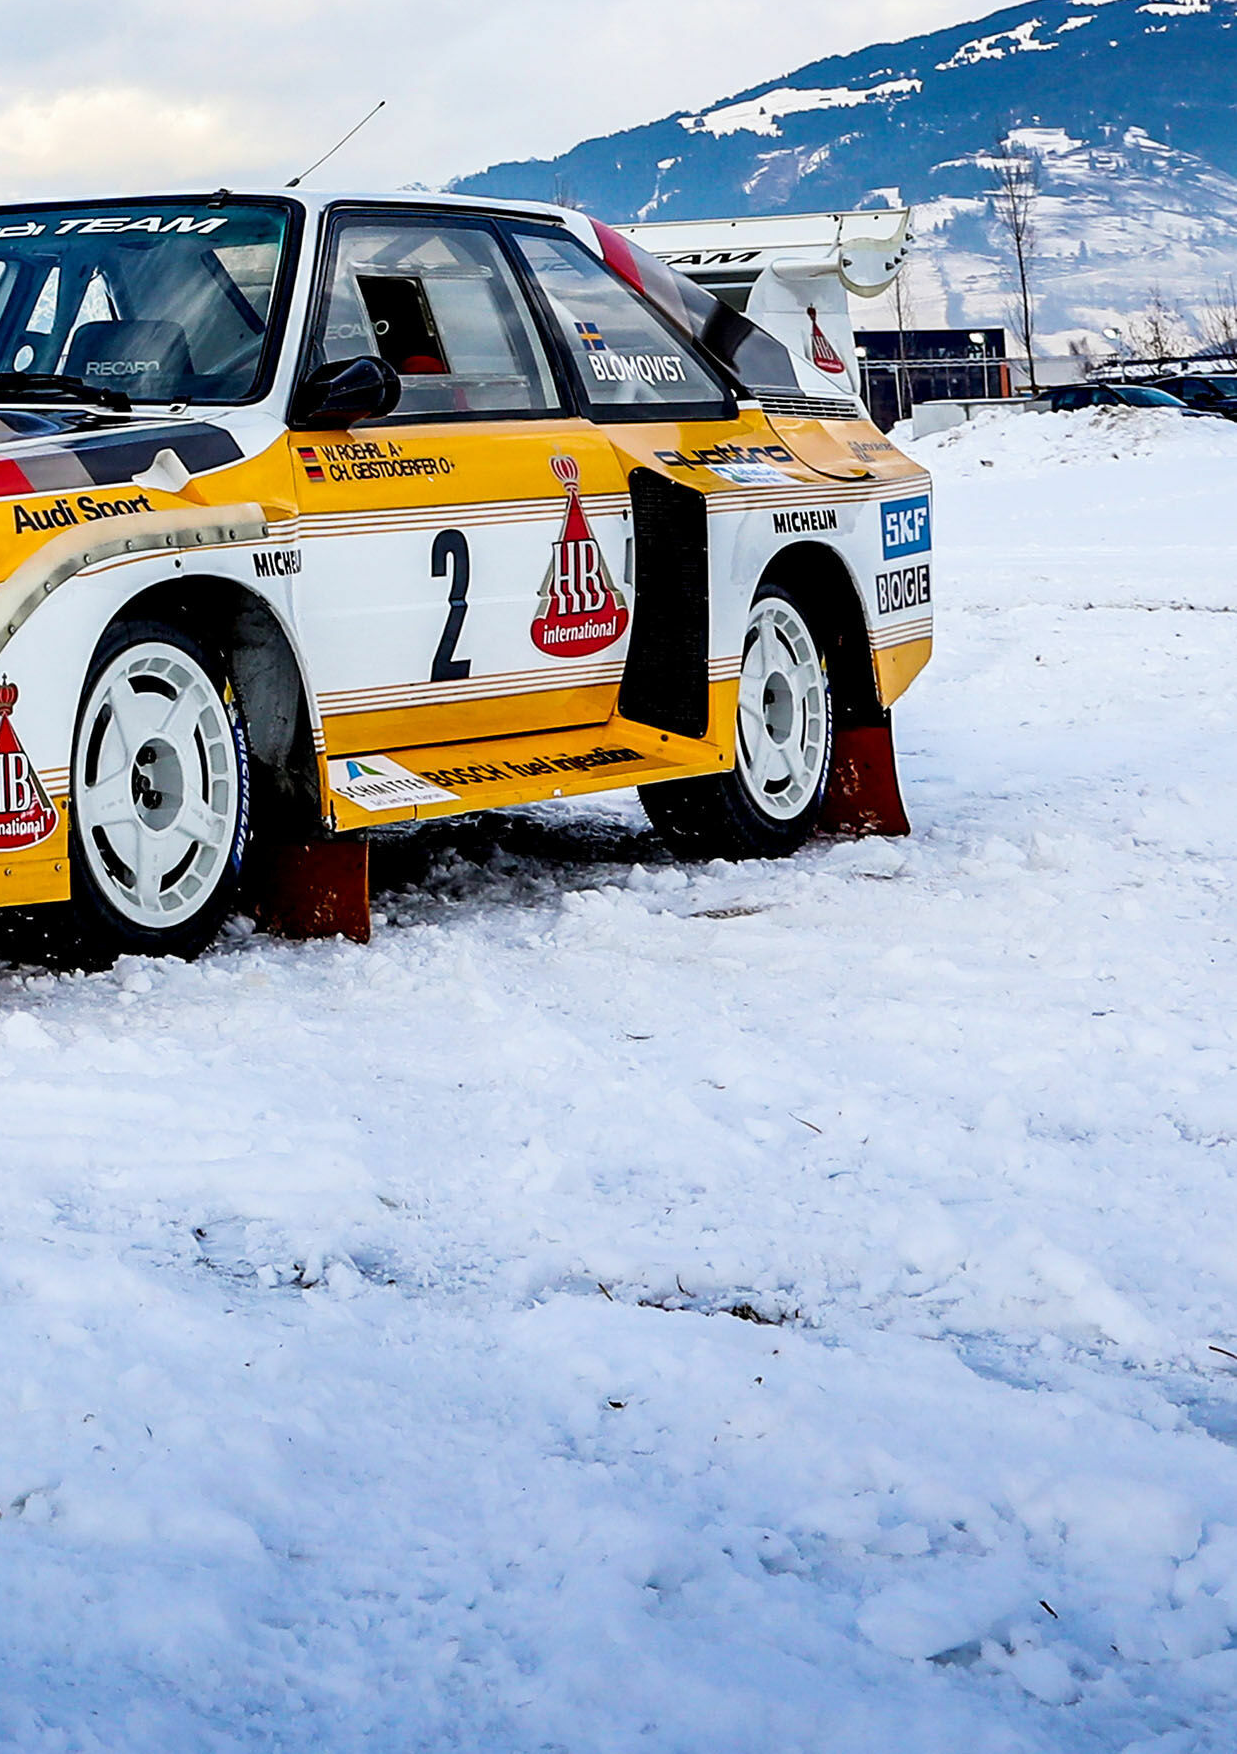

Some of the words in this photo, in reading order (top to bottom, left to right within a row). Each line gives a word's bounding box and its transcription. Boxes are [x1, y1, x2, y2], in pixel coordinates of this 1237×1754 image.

[55, 216, 229, 235] TEAM
[587, 353, 687, 386] BLOMQVIST
[654, 444, 794, 471] quattro
[13, 499, 80, 535] Audi
[77, 494, 157, 522] Sport
[773, 509, 838, 534] MICHELIN
[885, 507, 928, 548] SKF
[552, 538, 606, 616] HB
[876, 563, 930, 615] BOGE
[430, 528, 472, 683] 2
[543, 615, 618, 645] international
[420, 763, 513, 788] BOSCH
[502, 756, 553, 778] fuel
[545, 746, 646, 772] injection
